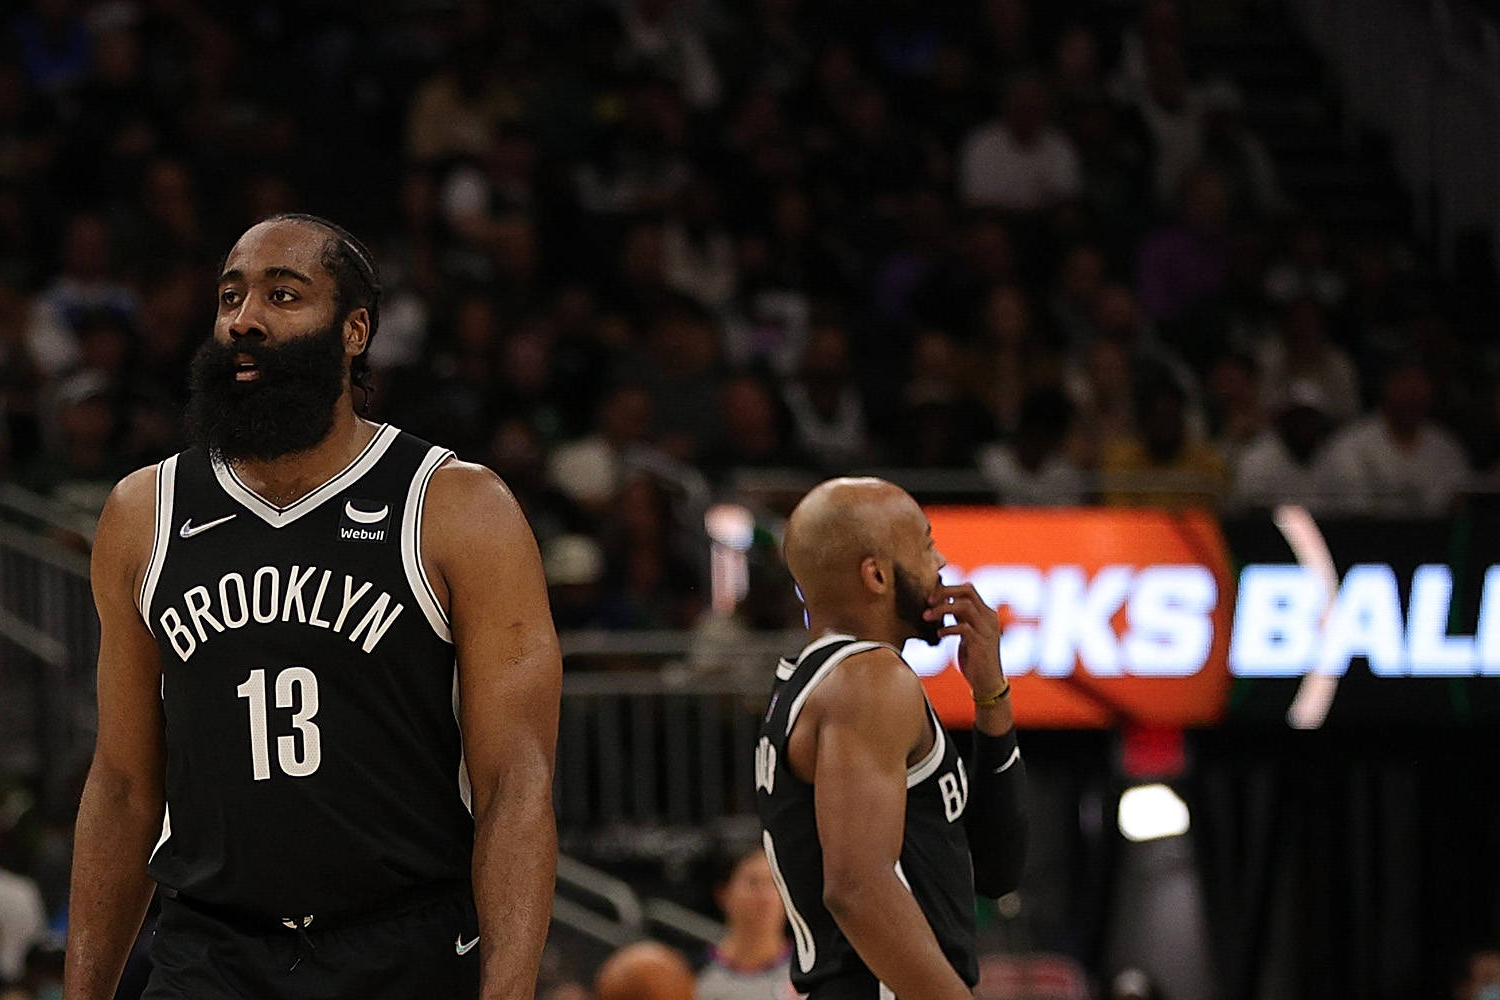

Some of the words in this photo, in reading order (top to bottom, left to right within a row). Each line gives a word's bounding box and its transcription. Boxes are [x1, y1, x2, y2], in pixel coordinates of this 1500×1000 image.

[340, 527, 385, 541] Webull
[159, 565, 404, 662] BROOKLYN
[237, 666, 321, 781] 13
